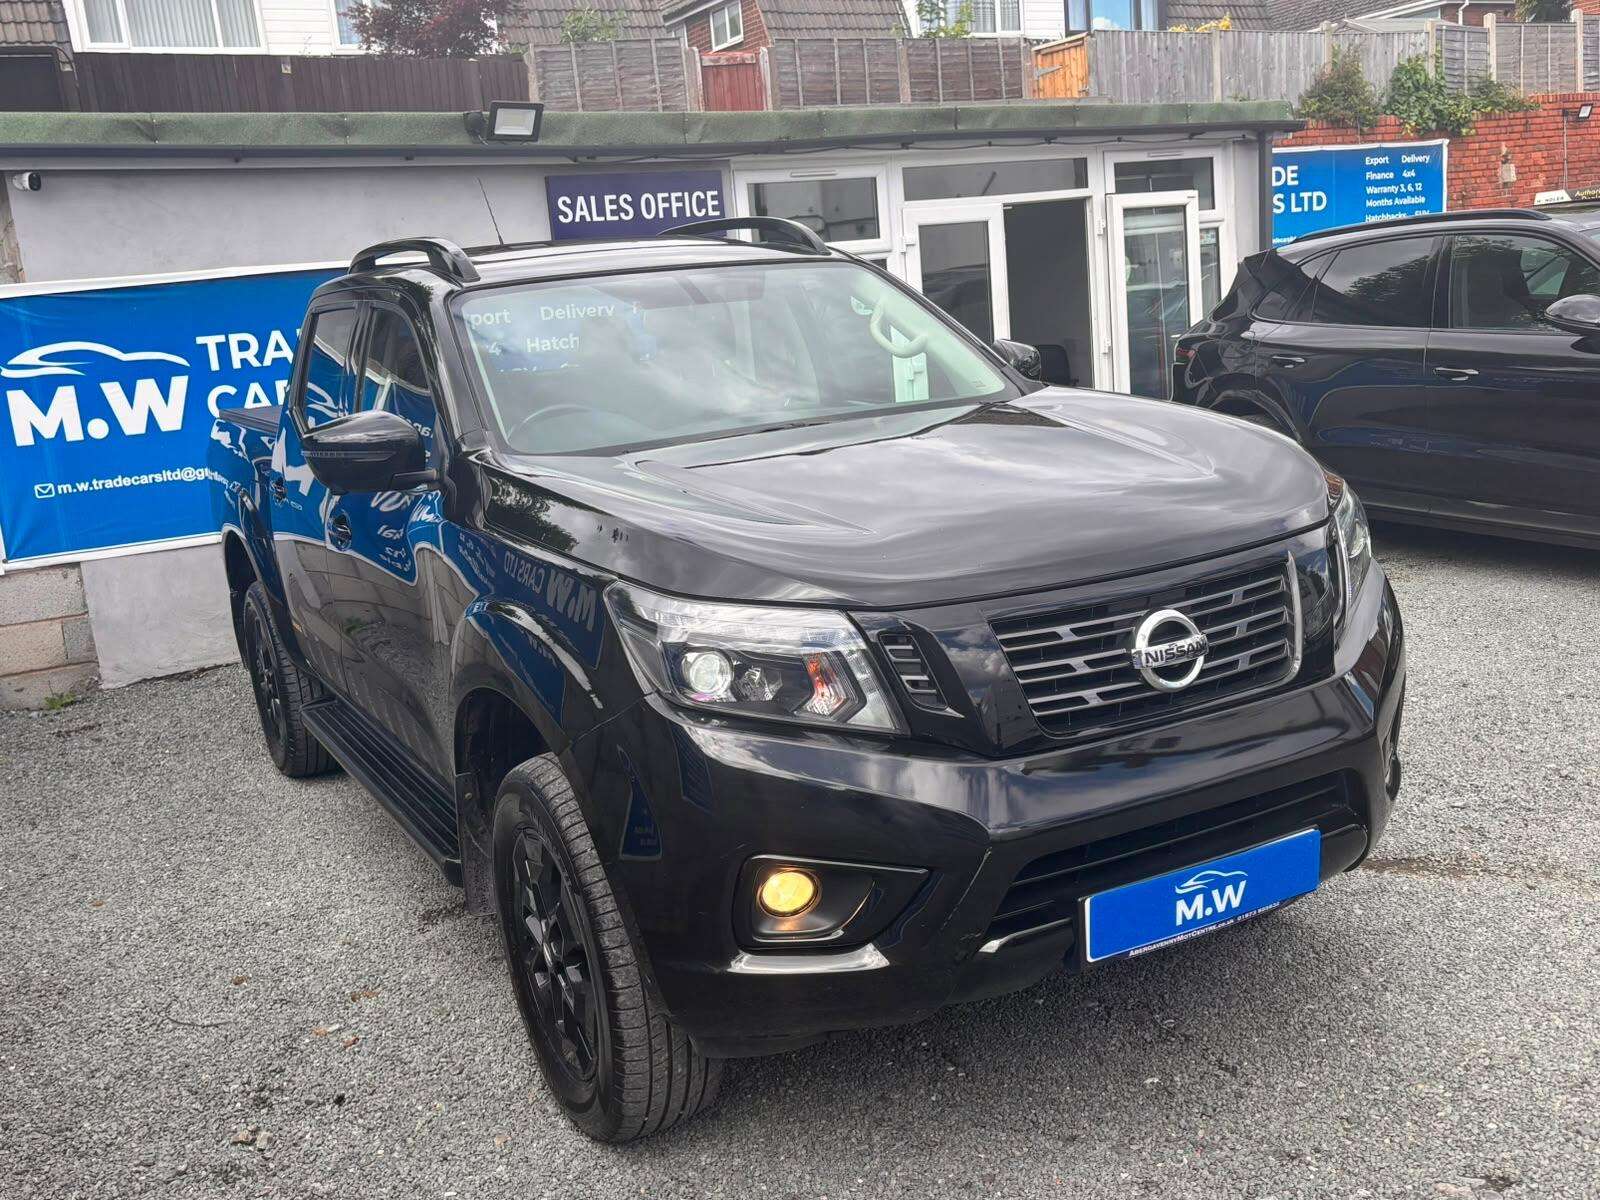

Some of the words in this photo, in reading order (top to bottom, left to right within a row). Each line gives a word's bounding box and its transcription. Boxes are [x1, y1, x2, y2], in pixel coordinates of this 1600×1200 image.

[1365, 156, 1390, 166] Export
[1401, 154, 1430, 164] Delivery
[1272, 165, 1299, 187] DE
[1365, 171, 1395, 180] Finance
[1402, 169, 1416, 178] 4x4
[1365, 185, 1399, 195] Warranty
[1415, 182, 1423, 191] 12
[557, 193, 635, 223] SALES
[640, 190, 720, 220] OFFICE
[1291, 191, 1327, 213] LTD
[1365, 198, 1393, 208] Months
[1393, 195, 1426, 206] Available
[467, 308, 511, 330] port
[195, 328, 302, 372] TRA
[5, 374, 189, 447] M.W
[1144, 640, 1206, 664] NISSAN
[1176, 879, 1247, 927] M.W
